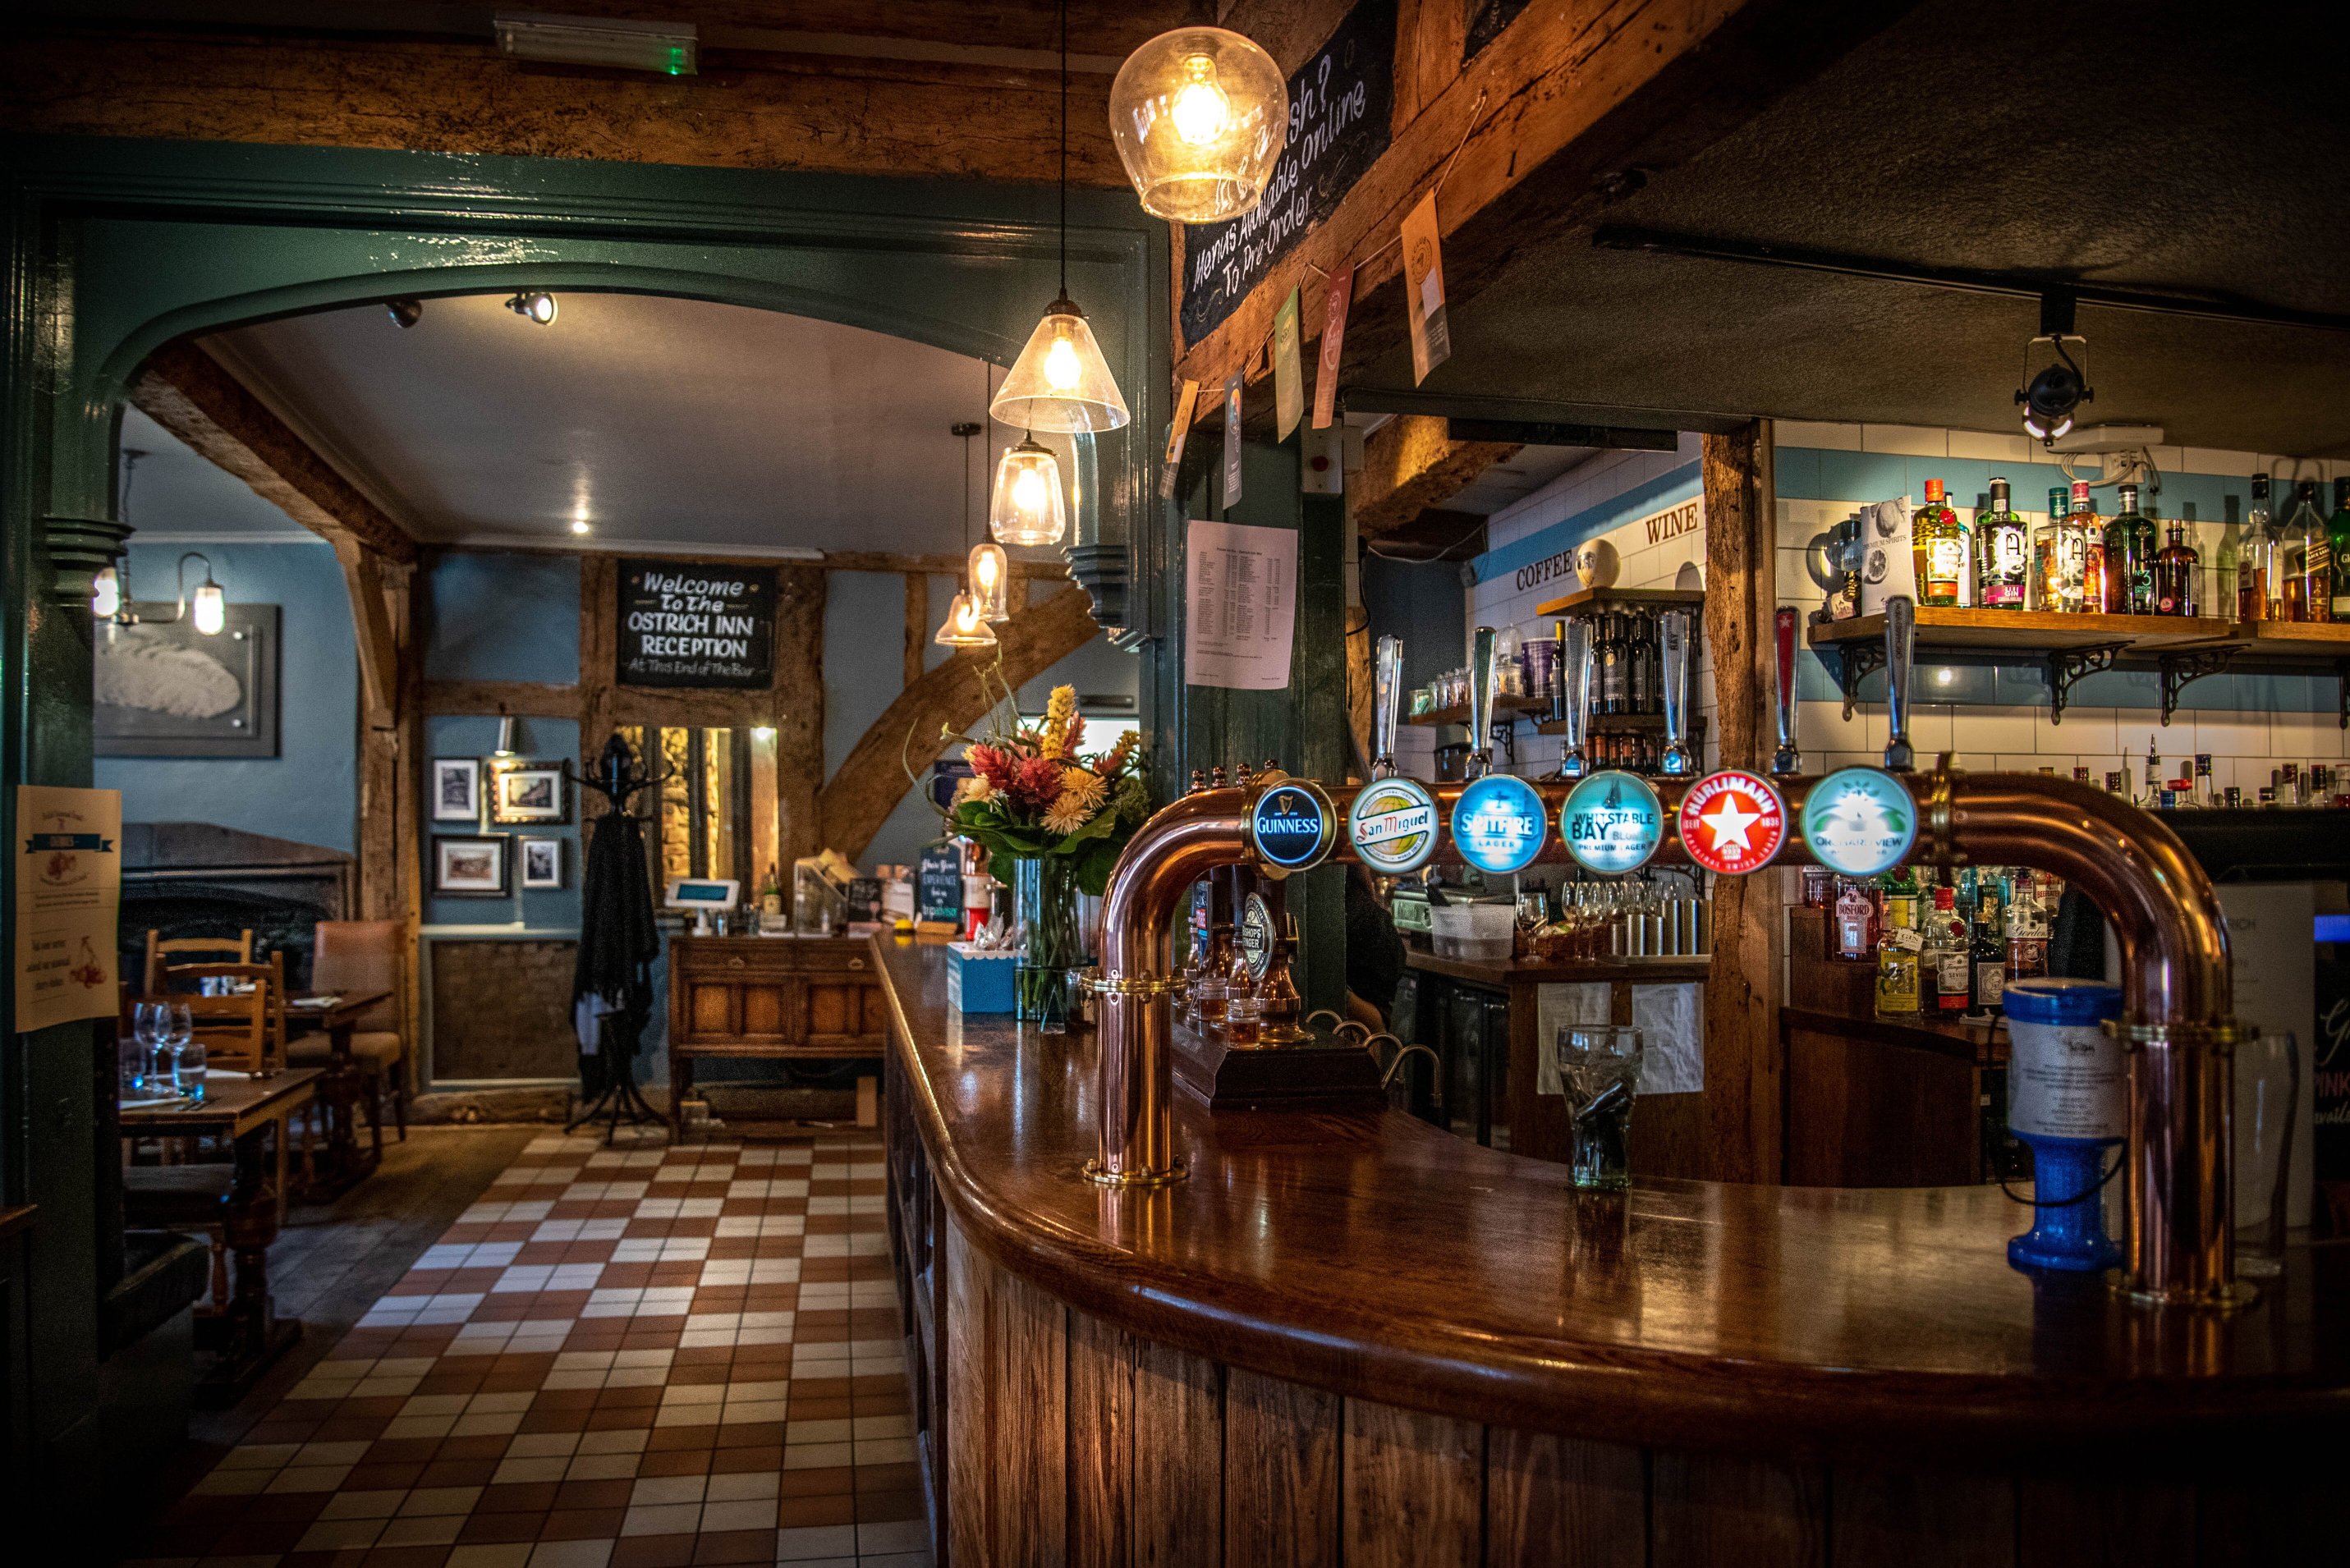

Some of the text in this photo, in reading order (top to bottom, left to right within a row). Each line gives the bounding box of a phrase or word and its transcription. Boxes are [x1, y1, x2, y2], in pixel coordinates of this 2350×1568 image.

[1193, 80, 1367, 292] Menus Available Online
[1223, 185, 1313, 298] To Pre-Order
[1645, 502, 1697, 545] WINE
[1886, 534, 1907, 544] SPIRITS
[1517, 549, 1572, 591] COFFEE
[2142, 570, 2151, 586] 3
[644, 571, 746, 598] Welcome
[660, 594, 684, 612] To
[628, 611, 755, 637] OSTRICH INN
[641, 634, 748, 658] RECEPTION
[674, 661, 698, 675] End
[1686, 776, 1777, 816] HÜRLIMANN
[1257, 817, 1319, 834] GUINNESS
[1356, 810, 1429, 842] San Miguel
[1575, 812, 1655, 824] WHITSTABLE
[1572, 821, 1651, 841] BAY BLOE
[1478, 840, 1515, 848] LAGER
[1875, 837, 1903, 847] VIEW
[1838, 904, 1870, 915] BOSFORD
[1242, 924, 1262, 938] BISHOPS
[1901, 933, 1919, 942] GIN
[1242, 937, 1260, 949] INGER
